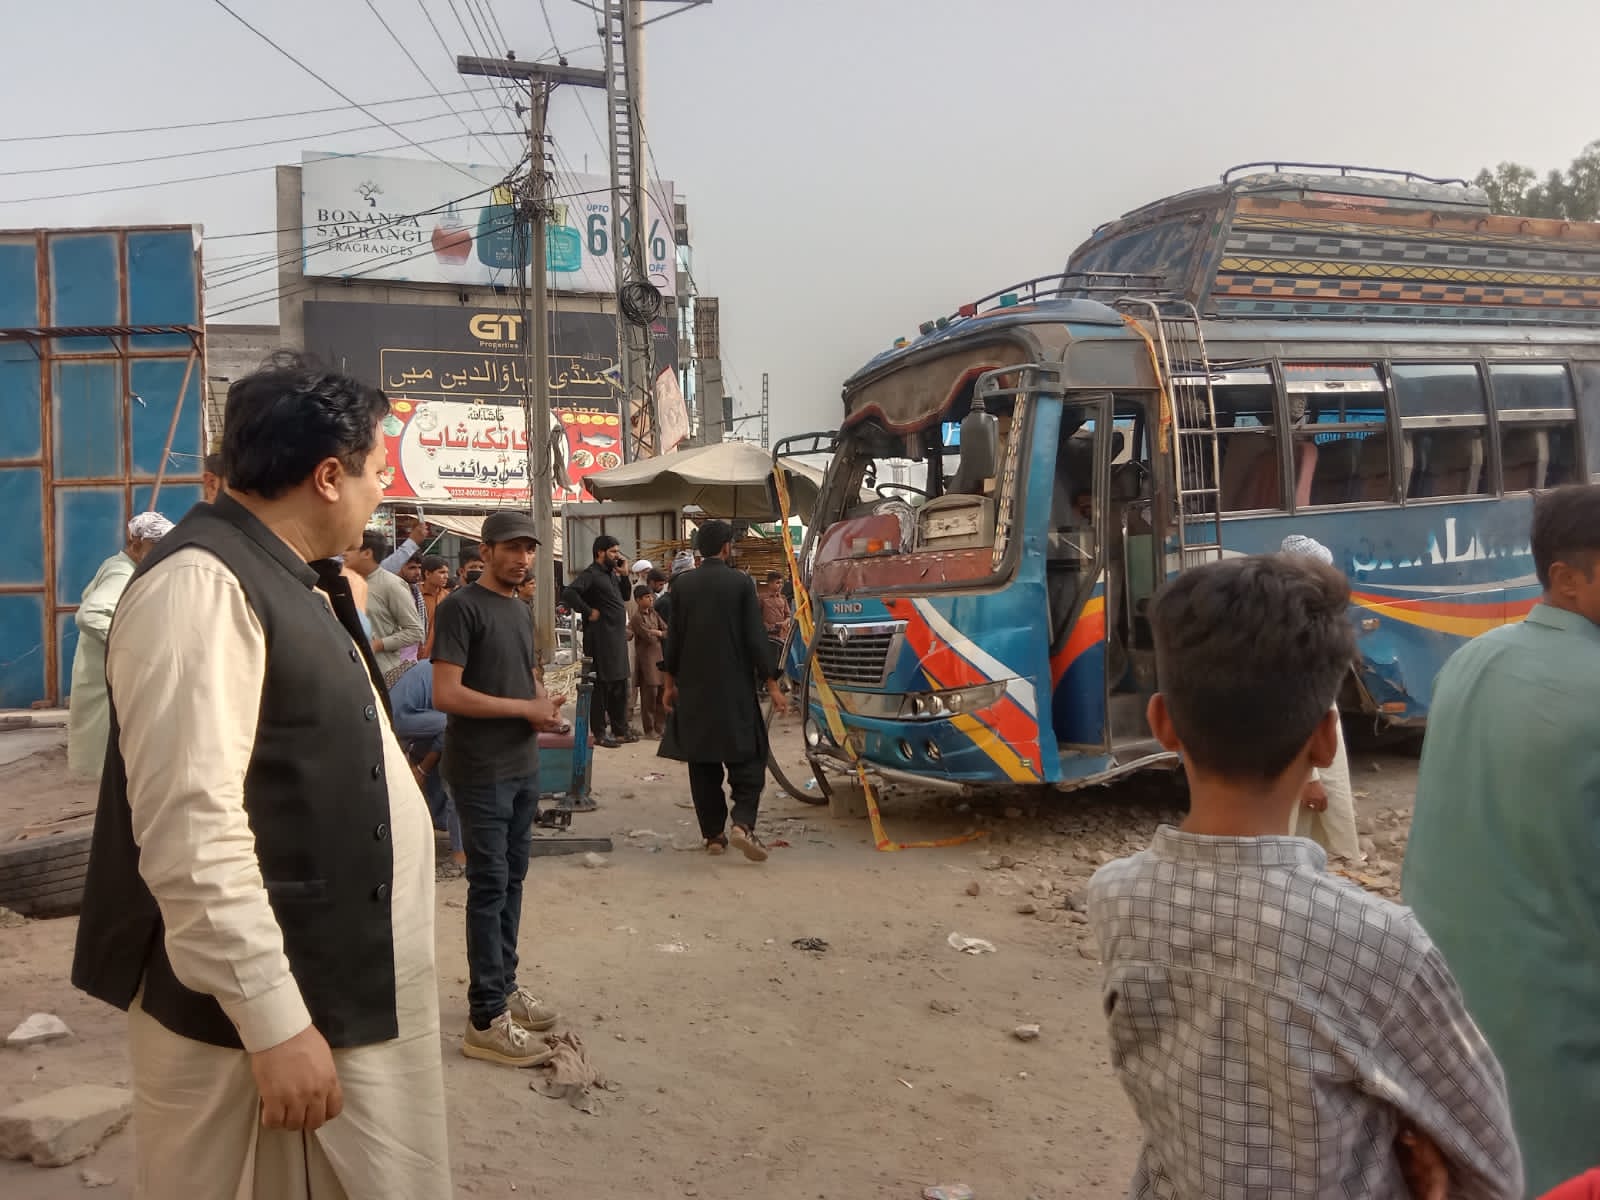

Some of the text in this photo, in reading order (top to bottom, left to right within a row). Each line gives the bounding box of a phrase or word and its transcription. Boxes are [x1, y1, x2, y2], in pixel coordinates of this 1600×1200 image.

[587, 204, 609, 212] UPTO
[318, 208, 421, 227] BONANZA
[317, 225, 422, 243] SATRANGI
[328, 241, 413, 256] FRAGRANCES
[649, 263, 666, 272] OFF
[469, 313, 522, 341] GT
[479, 340, 519, 350] Properties
[390, 366, 433, 388] میں
[419, 422, 469, 457] شاپ
[833, 602, 863, 613] HINO
